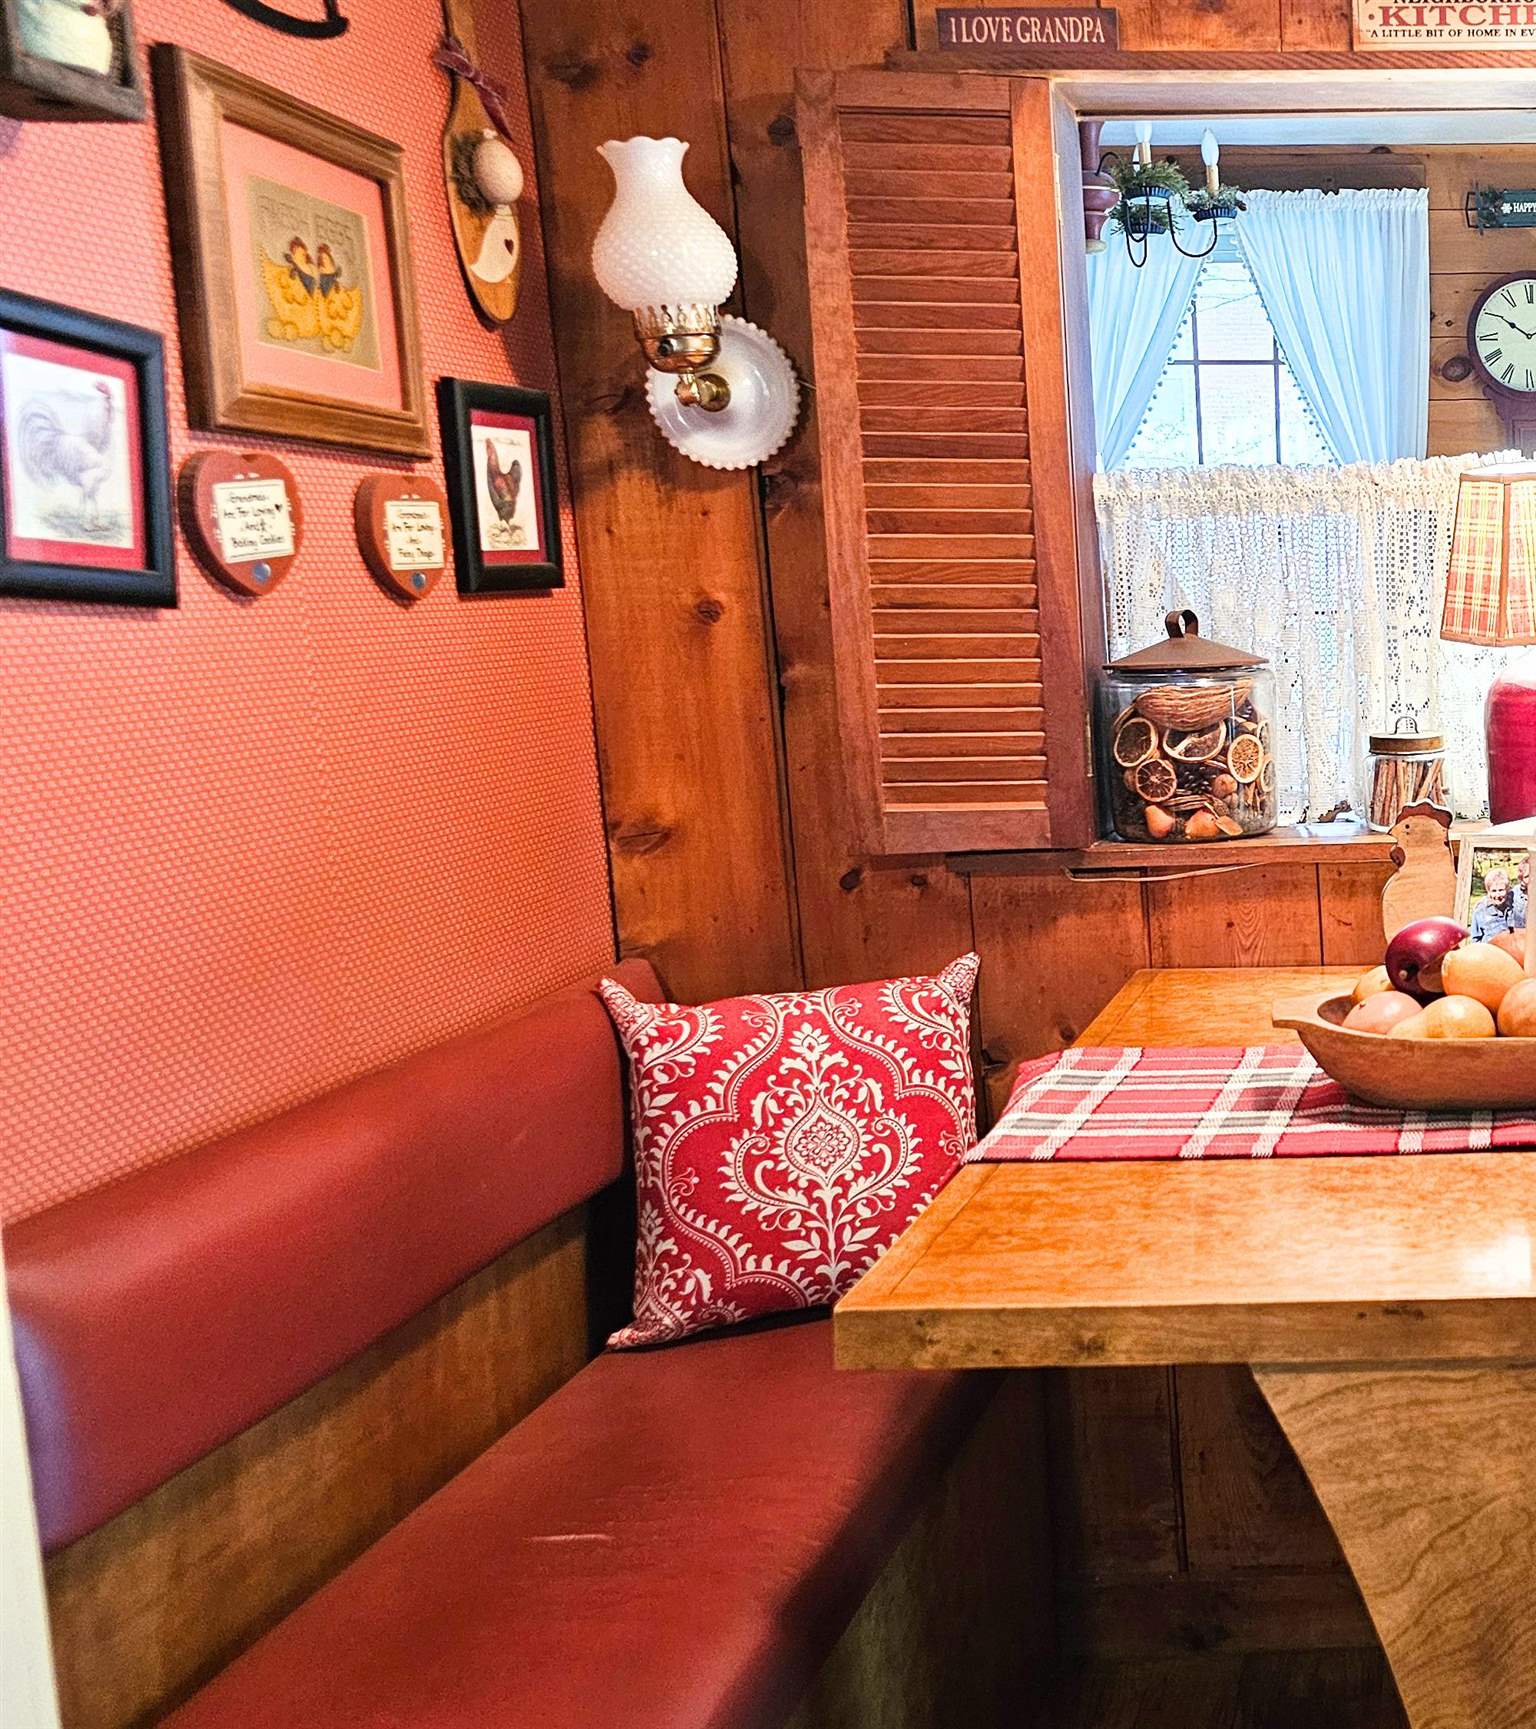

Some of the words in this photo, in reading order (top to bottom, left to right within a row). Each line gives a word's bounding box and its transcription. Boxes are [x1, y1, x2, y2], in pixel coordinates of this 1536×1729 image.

[950, 17, 957, 43] I
[961, 17, 1013, 44] LOVE
[1017, 16, 1105, 44] GRANDPA
[1382, 29, 1422, 38] LITTLE
[1427, 29, 1443, 38] BIT
[1448, 29, 1463, 37] OF
[1467, 29, 1501, 37] HOME
[1505, 29, 1517, 37] IN
